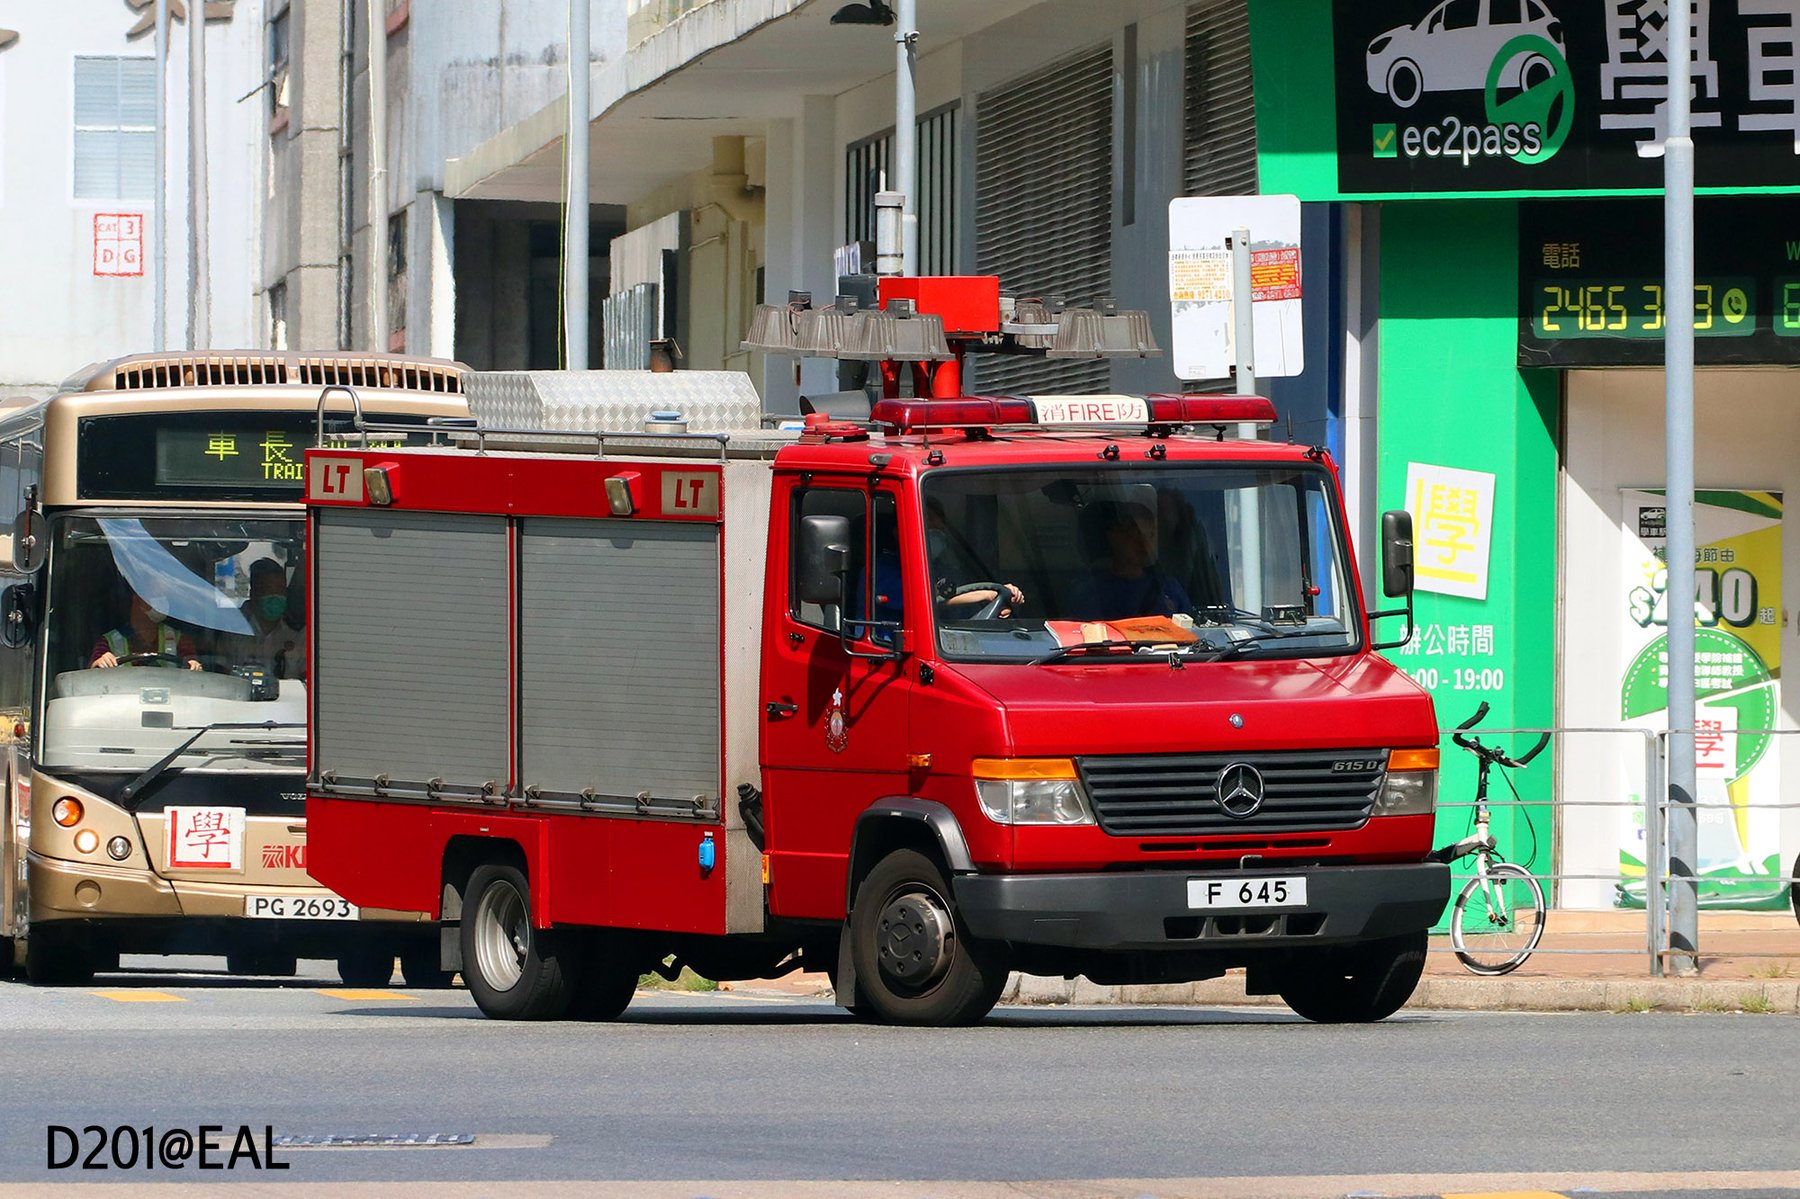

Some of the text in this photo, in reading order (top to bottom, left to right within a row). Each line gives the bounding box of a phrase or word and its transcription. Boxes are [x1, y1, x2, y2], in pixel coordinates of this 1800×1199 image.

[1404, 117, 1541, 166] ec2pass
[126, 220, 134, 235] 3
[103, 248, 136, 263] D G
[1542, 243, 1580, 269] 電話
[1543, 285, 1628, 331] 2465
[1068, 404, 1115, 421] FIRE
[323, 465, 350, 494] LT
[675, 479, 704, 508] LT
[1425, 484, 1480, 565] 學
[1453, 668, 1504, 690] 19:00
[1333, 760, 1378, 772] 615 D
[185, 811, 231, 858] 學
[1207, 881, 1288, 904] F 645
[255, 898, 351, 918] PG 2693
